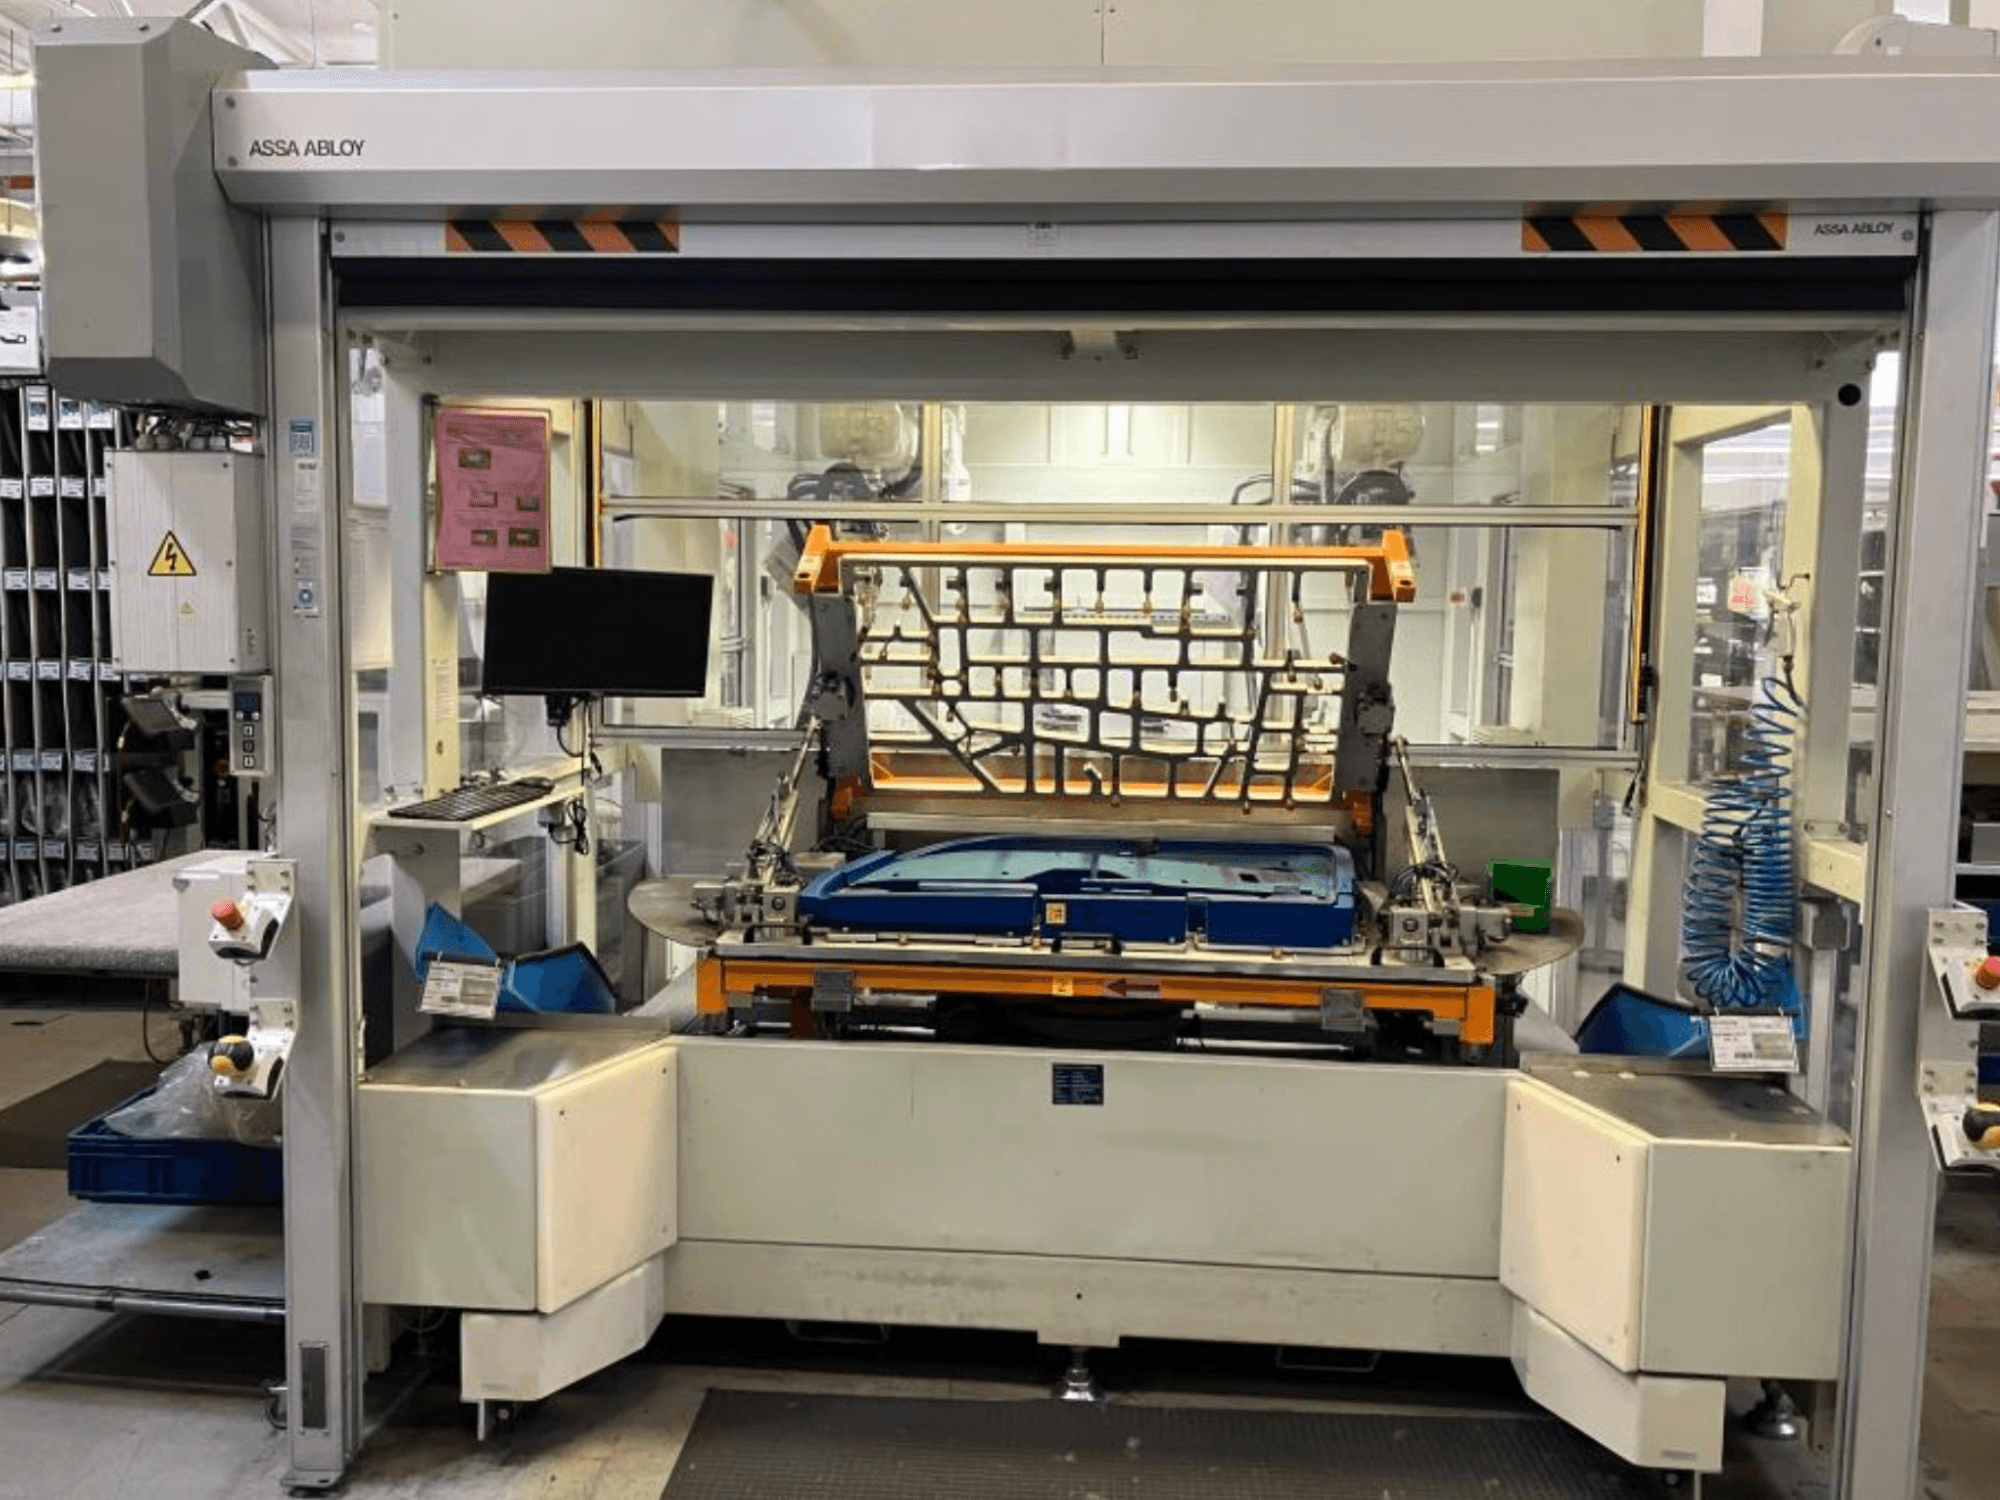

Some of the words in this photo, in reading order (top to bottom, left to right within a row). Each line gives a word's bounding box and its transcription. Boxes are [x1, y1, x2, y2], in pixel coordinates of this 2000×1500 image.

[249, 139, 299, 157] ASSA
[304, 139, 365, 157] ABLOY
[1814, 223, 1849, 236] ASSA
[1852, 221, 1894, 234] ABLOY
